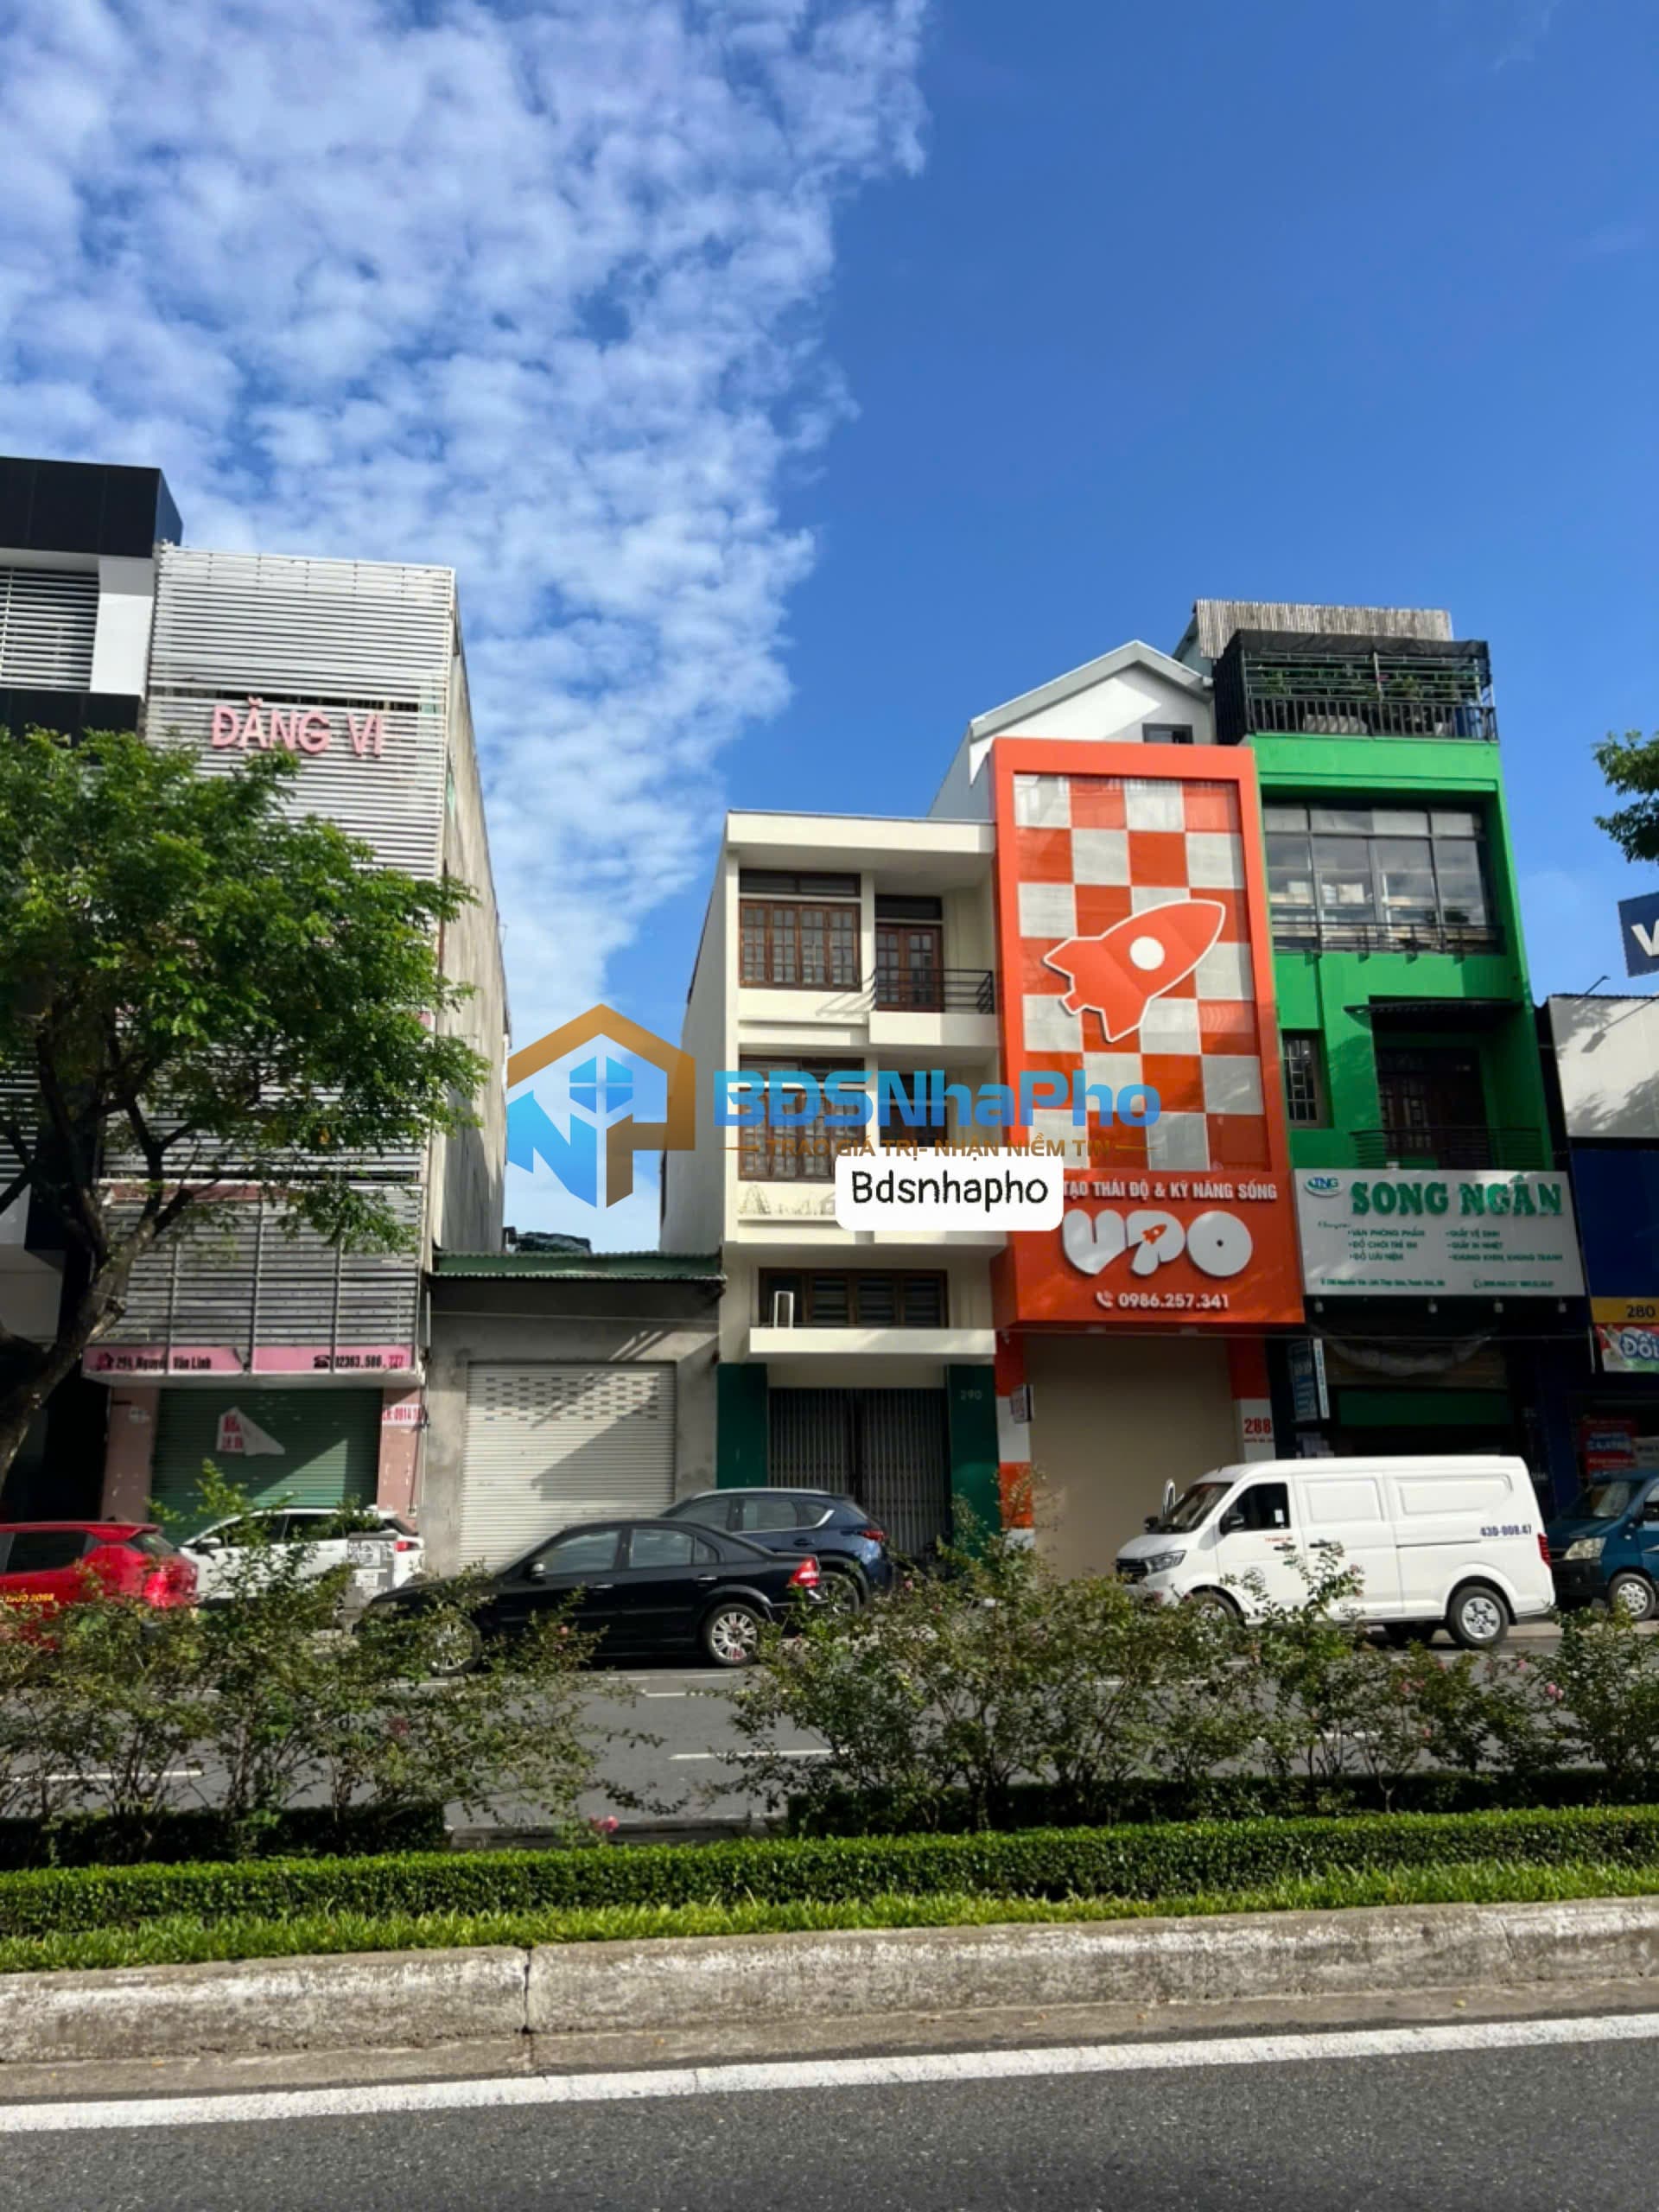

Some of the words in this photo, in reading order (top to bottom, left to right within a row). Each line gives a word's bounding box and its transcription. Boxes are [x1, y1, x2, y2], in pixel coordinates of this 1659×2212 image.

[1093, 1179, 1126, 1198] THÁI
[1129, 1181, 1149, 1201] ĐỘ
[1154, 1182, 1166, 1198] &
[1170, 1179, 1189, 1198] KỸ
[1192, 1180, 1234, 1200] NĂNG
[1237, 1179, 1278, 1200] SỐNG
[1350, 1181, 1450, 1217] SONG
[1458, 1174, 1563, 1217] NGÂN
[1117, 1292, 1230, 1310] 0986.257.341
[1626, 1304, 1656, 1318] 280
[1244, 1418, 1272, 1434] 288
